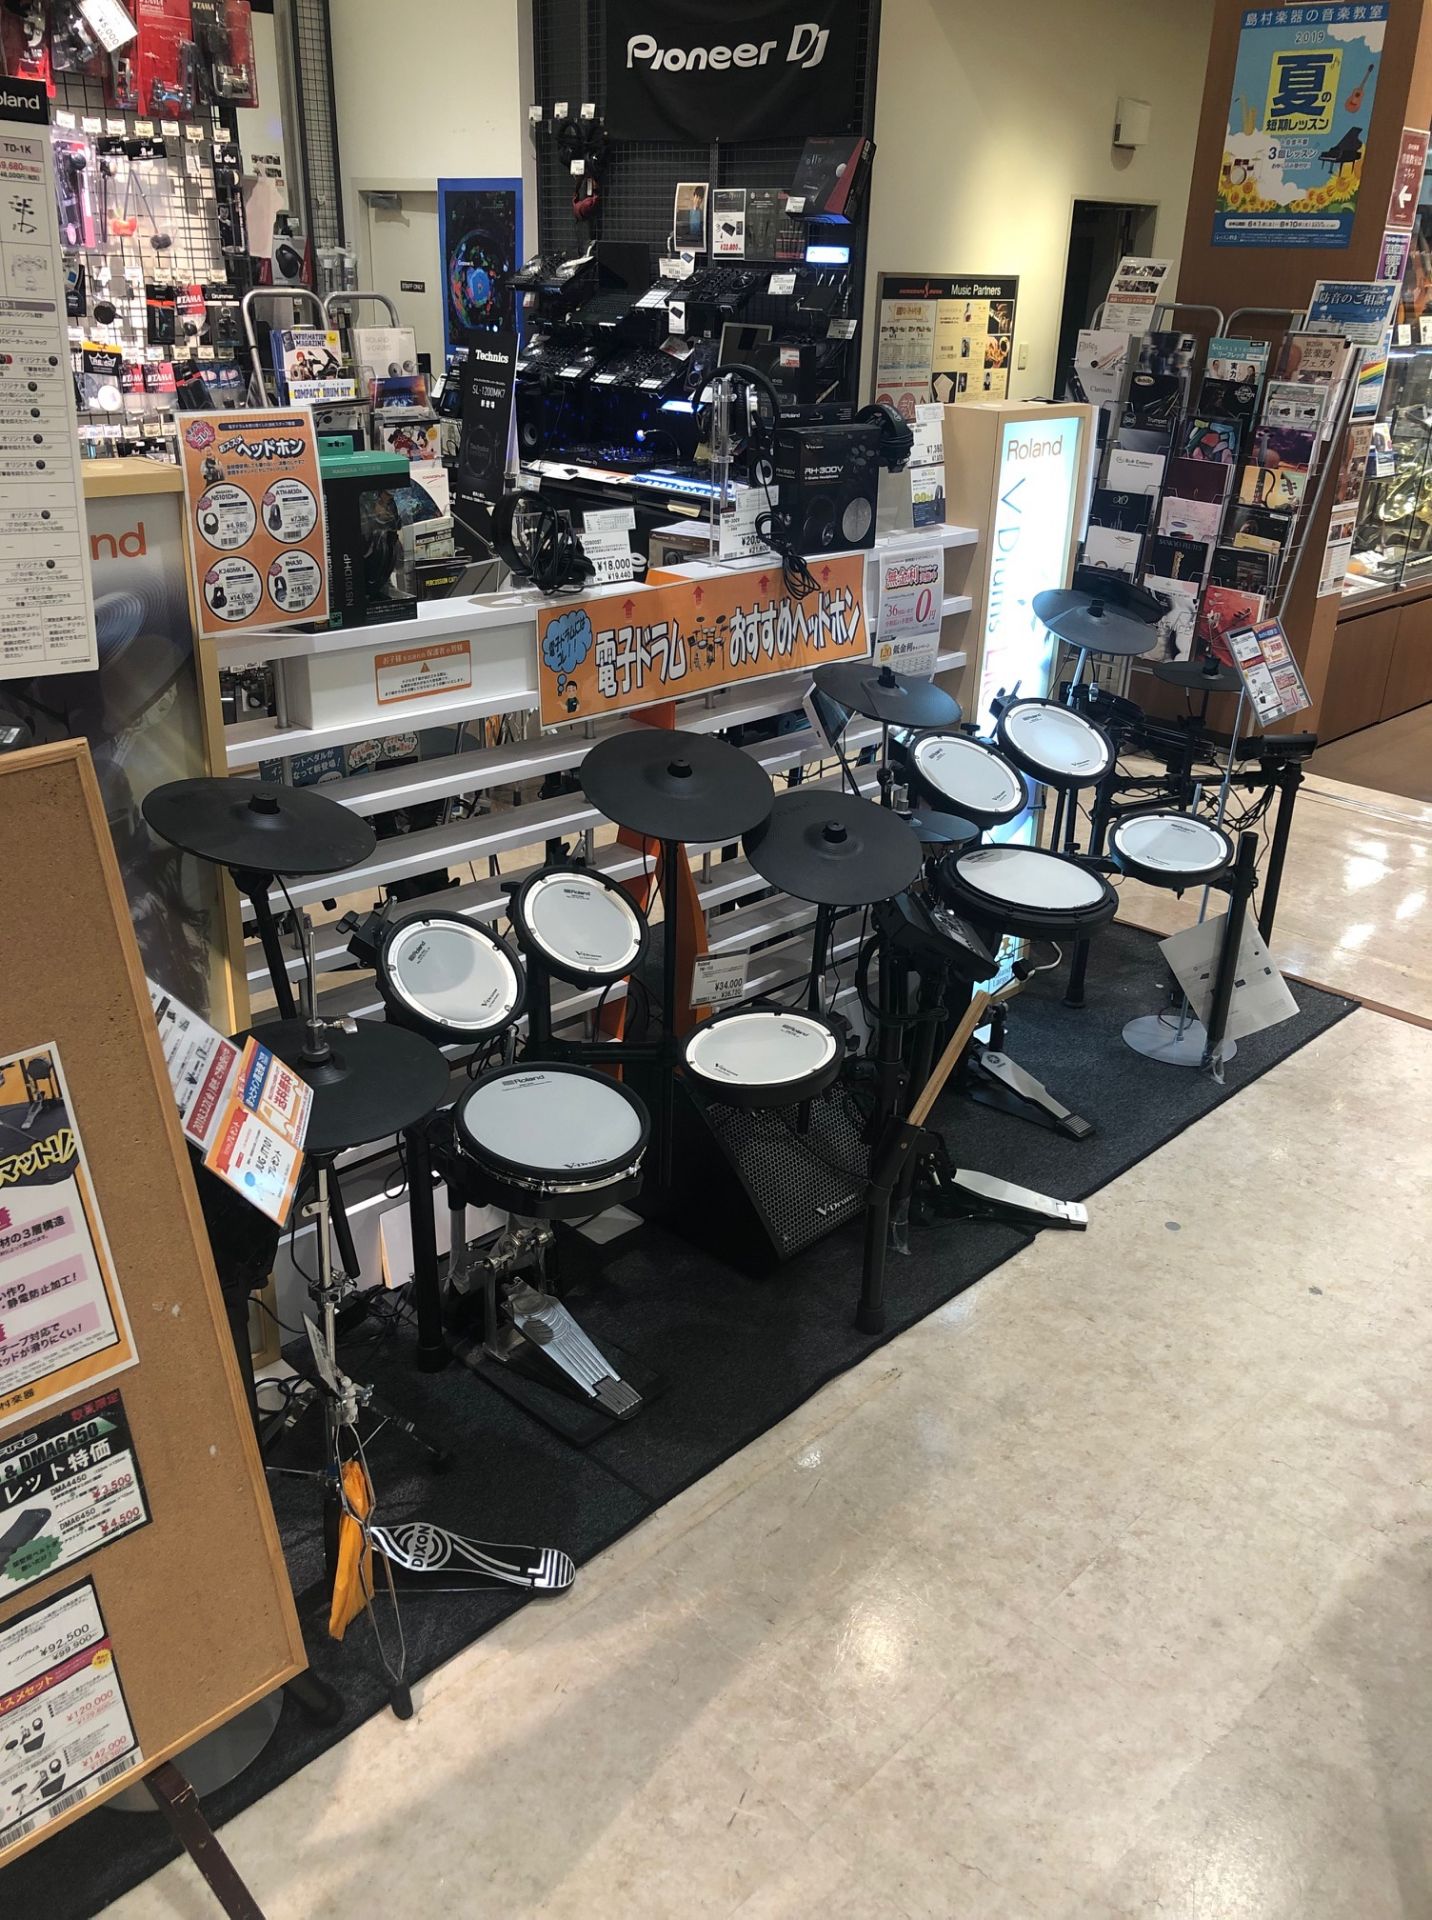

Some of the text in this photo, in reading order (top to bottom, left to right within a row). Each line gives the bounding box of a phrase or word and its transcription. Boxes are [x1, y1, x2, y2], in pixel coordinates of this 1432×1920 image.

[1245, 5, 1384, 26] 島村楽器の音楽教室
[1295, 31, 1325, 43] 2019
[626, 23, 830, 71] Pioneer DJ
[1266, 118, 1329, 131] 短期レッスン
[3, 143, 32, 154] TD-1K
[951, 284, 971, 295] Music
[972, 284, 1002, 296] Partners
[1319, 292, 1386, 306] 防音のご相談
[293, 333, 327, 341] INFORMATION
[475, 349, 509, 364] Technics
[1302, 360, 1335, 368] フェスタ
[294, 387, 351, 399] COMPACT DRUM KIT
[471, 383, 506, 399] SL-1200MK7
[236, 439, 304, 458] ヘッドホン
[1006, 435, 1063, 462] Roland
[804, 465, 844, 475] RH-300V
[597, 558, 631, 572] ¥18,000
[607, 571, 632, 580] ¥19,440
[594, 584, 862, 699] 電子ドラム おすすめヘッドホン
[567, 888, 592, 896] Roland
[409, 940, 426, 960] Roland
[714, 977, 743, 991] ¥34,000
[508, 1074, 545, 1086] Roland
[562, 1158, 608, 1169] V-Drums
[4, 1421, 99, 1479] & DMA6450
[5, 1437, 112, 1504] レット特価
[50, 1473, 87, 1496] DMA4450
[59, 1507, 96, 1531] DMA6450
[411, 1525, 431, 1568] DIXON
[40, 1623, 90, 1657] ¥92,500
[66, 1689, 114, 1722] ¥120,000
[82, 1735, 127, 1770] ¥142,000
